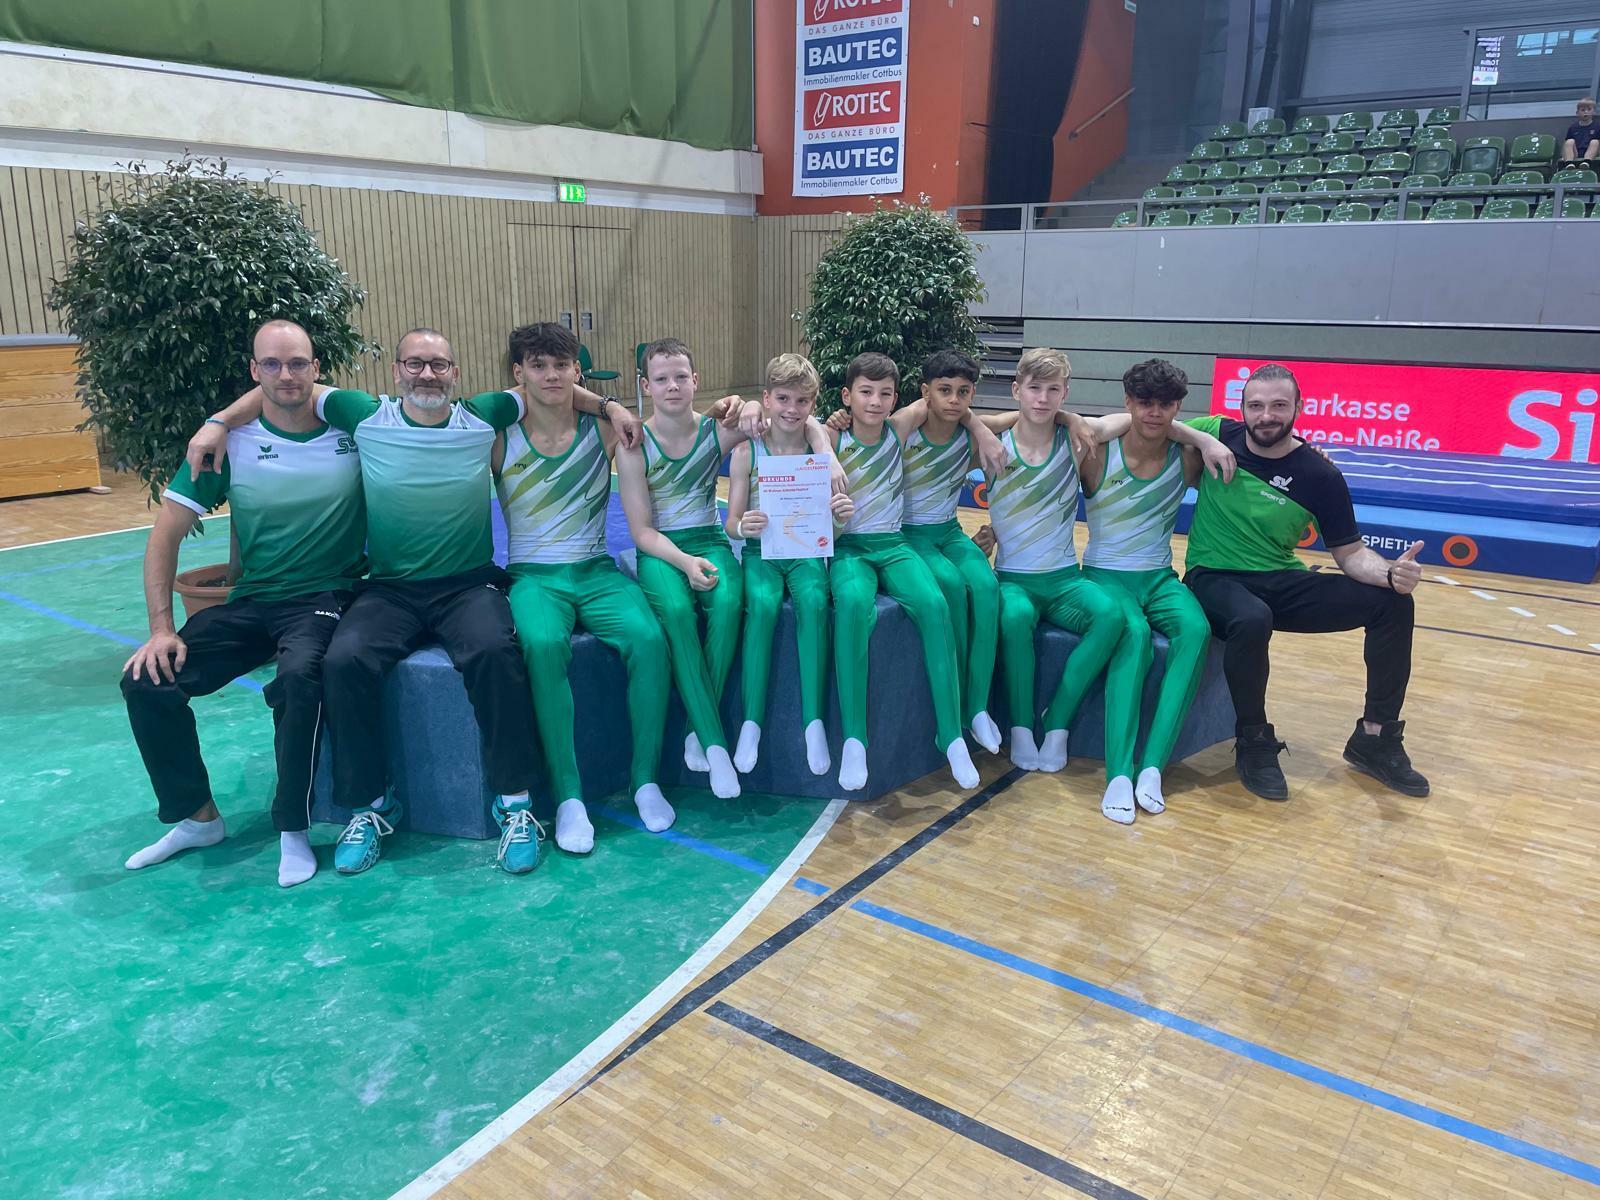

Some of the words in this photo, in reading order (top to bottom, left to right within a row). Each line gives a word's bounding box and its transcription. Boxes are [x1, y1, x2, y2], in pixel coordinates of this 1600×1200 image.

[808, 26, 826, 36] DAS
[833, 21, 865, 33] GANZE
[870, 16, 898, 27] BÜRO
[808, 37, 897, 67] BAUTEC
[804, 71, 870, 86] Immobilienmakler
[872, 68, 903, 79] Cottbus
[832, 90, 892, 117] ROTEC
[808, 131, 826, 141] DAS
[831, 128, 864, 139] GANZE
[869, 126, 896, 136] BÜRO
[806, 146, 895, 171] BAUTEC
[801, 177, 868, 189] Immobilienmakler
[870, 175, 898, 186] Cottbus
[1302, 393, 1410, 422] arkasse
[1291, 427, 1440, 451] ree-Neiße
[257, 453, 279, 461] erima
[1361, 534, 1415, 551] SPIETH
